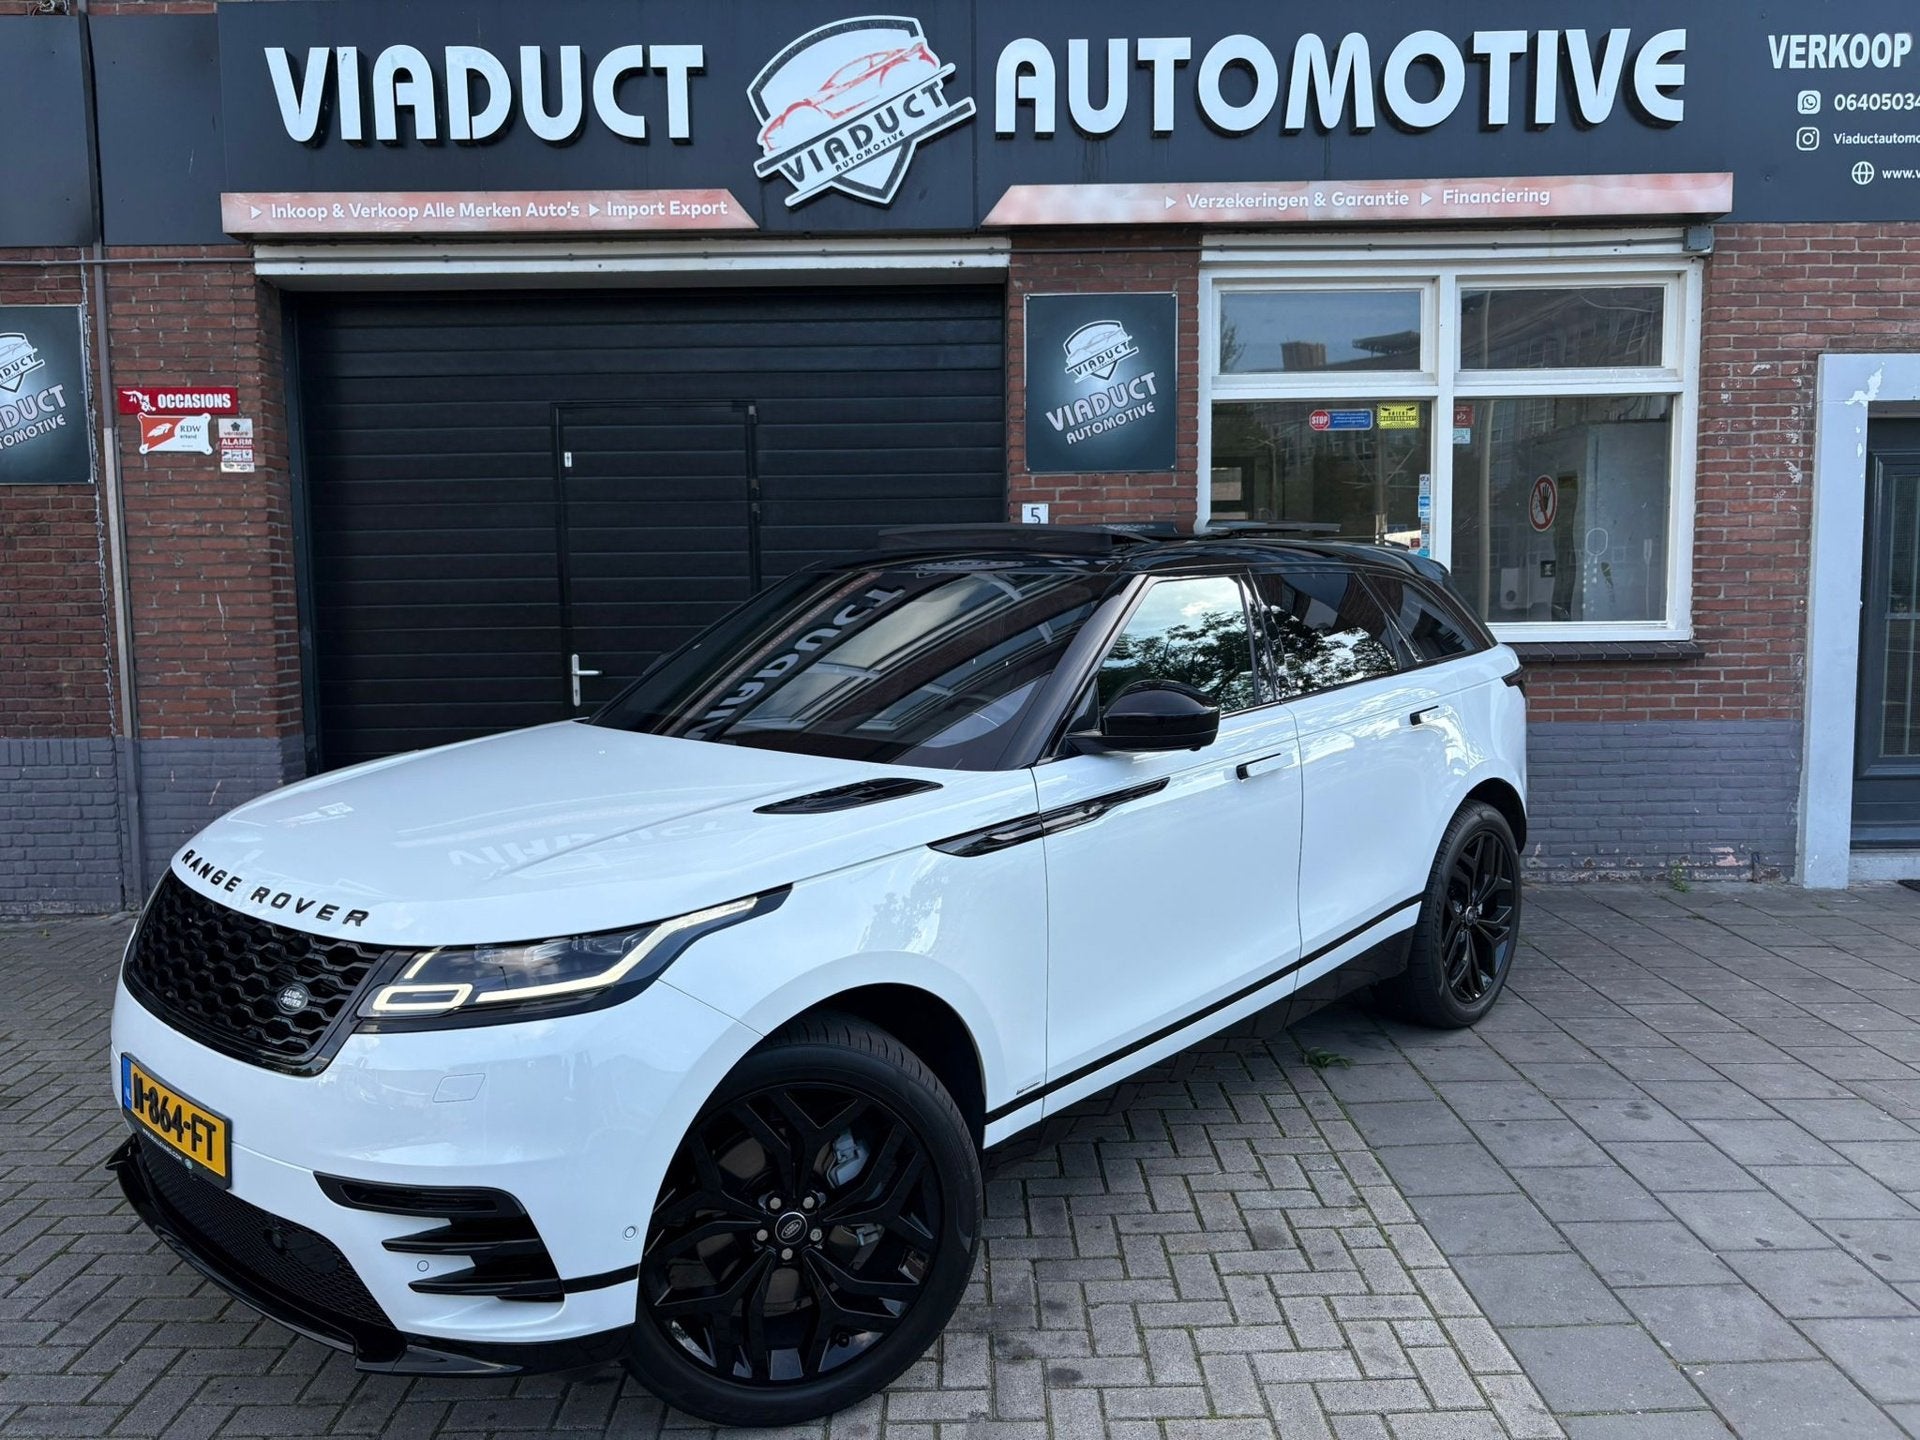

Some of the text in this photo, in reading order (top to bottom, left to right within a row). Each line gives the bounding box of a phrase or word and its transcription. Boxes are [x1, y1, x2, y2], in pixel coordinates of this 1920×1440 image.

[1767, 33, 1912, 69] VERKOOP
[264, 28, 1688, 143] VIADUCT AUTOMOTIVE
[782, 81, 944, 182] VIADUCT
[835, 130, 905, 172] AUTOMOTIVE
[271, 202, 579, 221] Inkoop & Verkoop Alle Merken Auto's
[608, 200, 728, 219] Import Export
[1187, 190, 1409, 210] Verzekeringen & Garantie
[1443, 187, 1550, 206] Financiering
[0, 354, 34, 380] DUCT
[1074, 342, 1128, 375] VIADUCT
[0, 384, 66, 431] DUCT
[157, 394, 231, 408] OCCASIONS
[1046, 372, 1158, 432] VIADUCT
[1066, 401, 1156, 445] AUTOMOTIVE
[1311, 415, 1328, 425] STOP
[181, 849, 369, 927] RANGE ROVER
